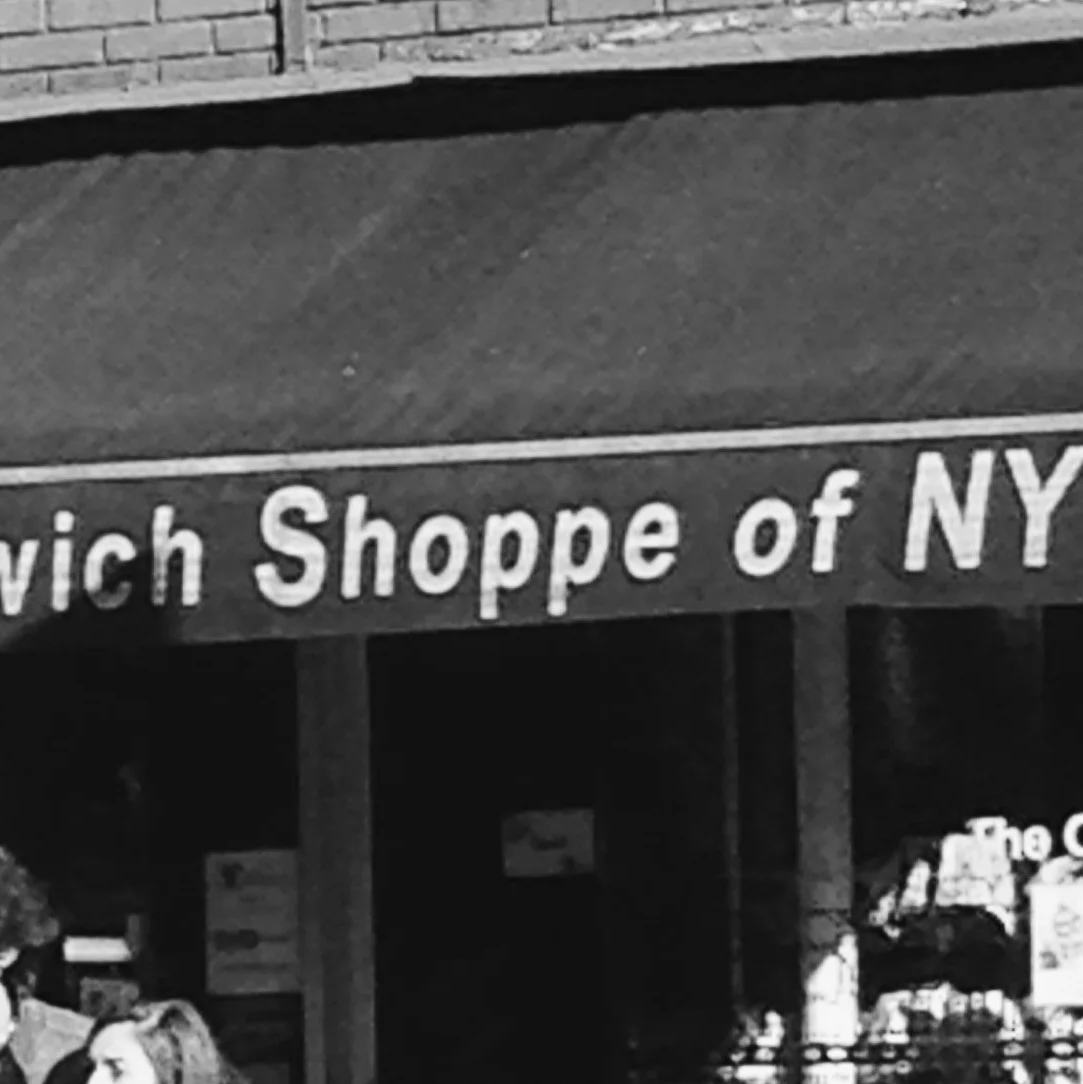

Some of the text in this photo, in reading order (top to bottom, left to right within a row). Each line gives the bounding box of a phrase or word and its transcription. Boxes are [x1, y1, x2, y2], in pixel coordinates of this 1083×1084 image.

[255, 485, 679, 619] Shoppe
[734, 469, 860, 576] of
[904, 446, 1083, 571] NY
